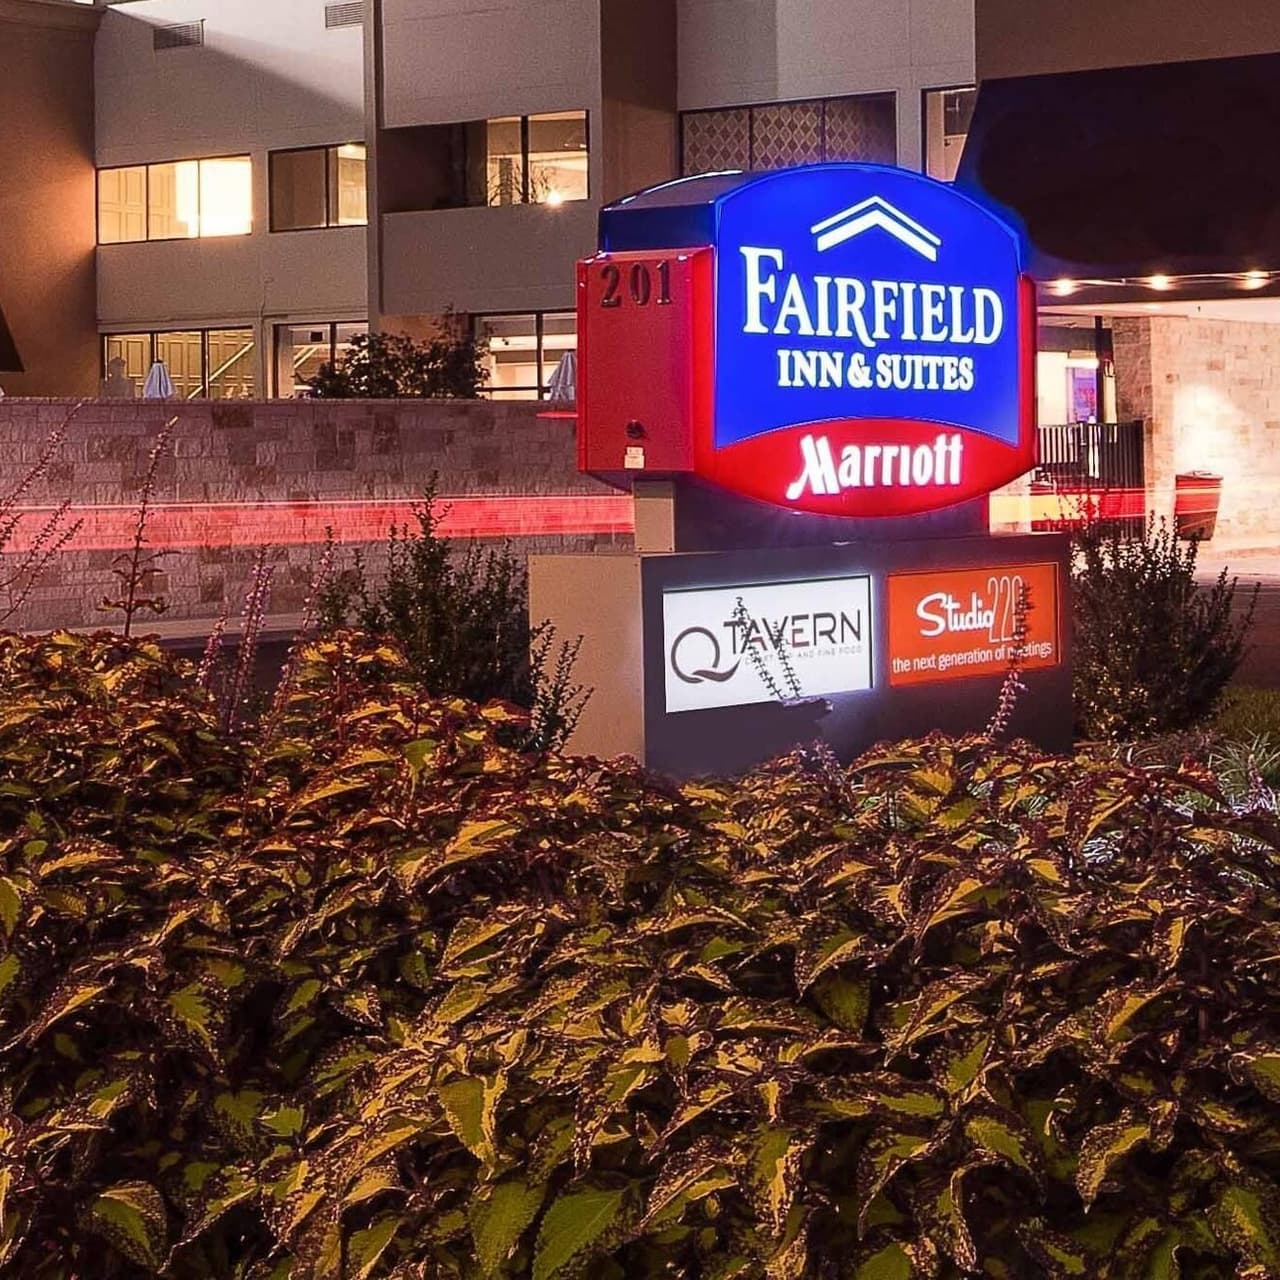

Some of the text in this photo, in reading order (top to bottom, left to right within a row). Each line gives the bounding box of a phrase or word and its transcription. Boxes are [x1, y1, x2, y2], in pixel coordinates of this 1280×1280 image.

[599, 260, 672, 308] 201
[739, 246, 1004, 348] FAIRFIELD
[777, 349, 975, 391] INN & SUITES
[785, 433, 963, 500] Marriott
[916, 592, 995, 636] Studio
[671, 609, 861, 684] Q TAVERN
[892, 657, 911, 673] the
[913, 654, 937, 670] next
[938, 647, 992, 670] generation
[994, 646, 1006, 660] of
